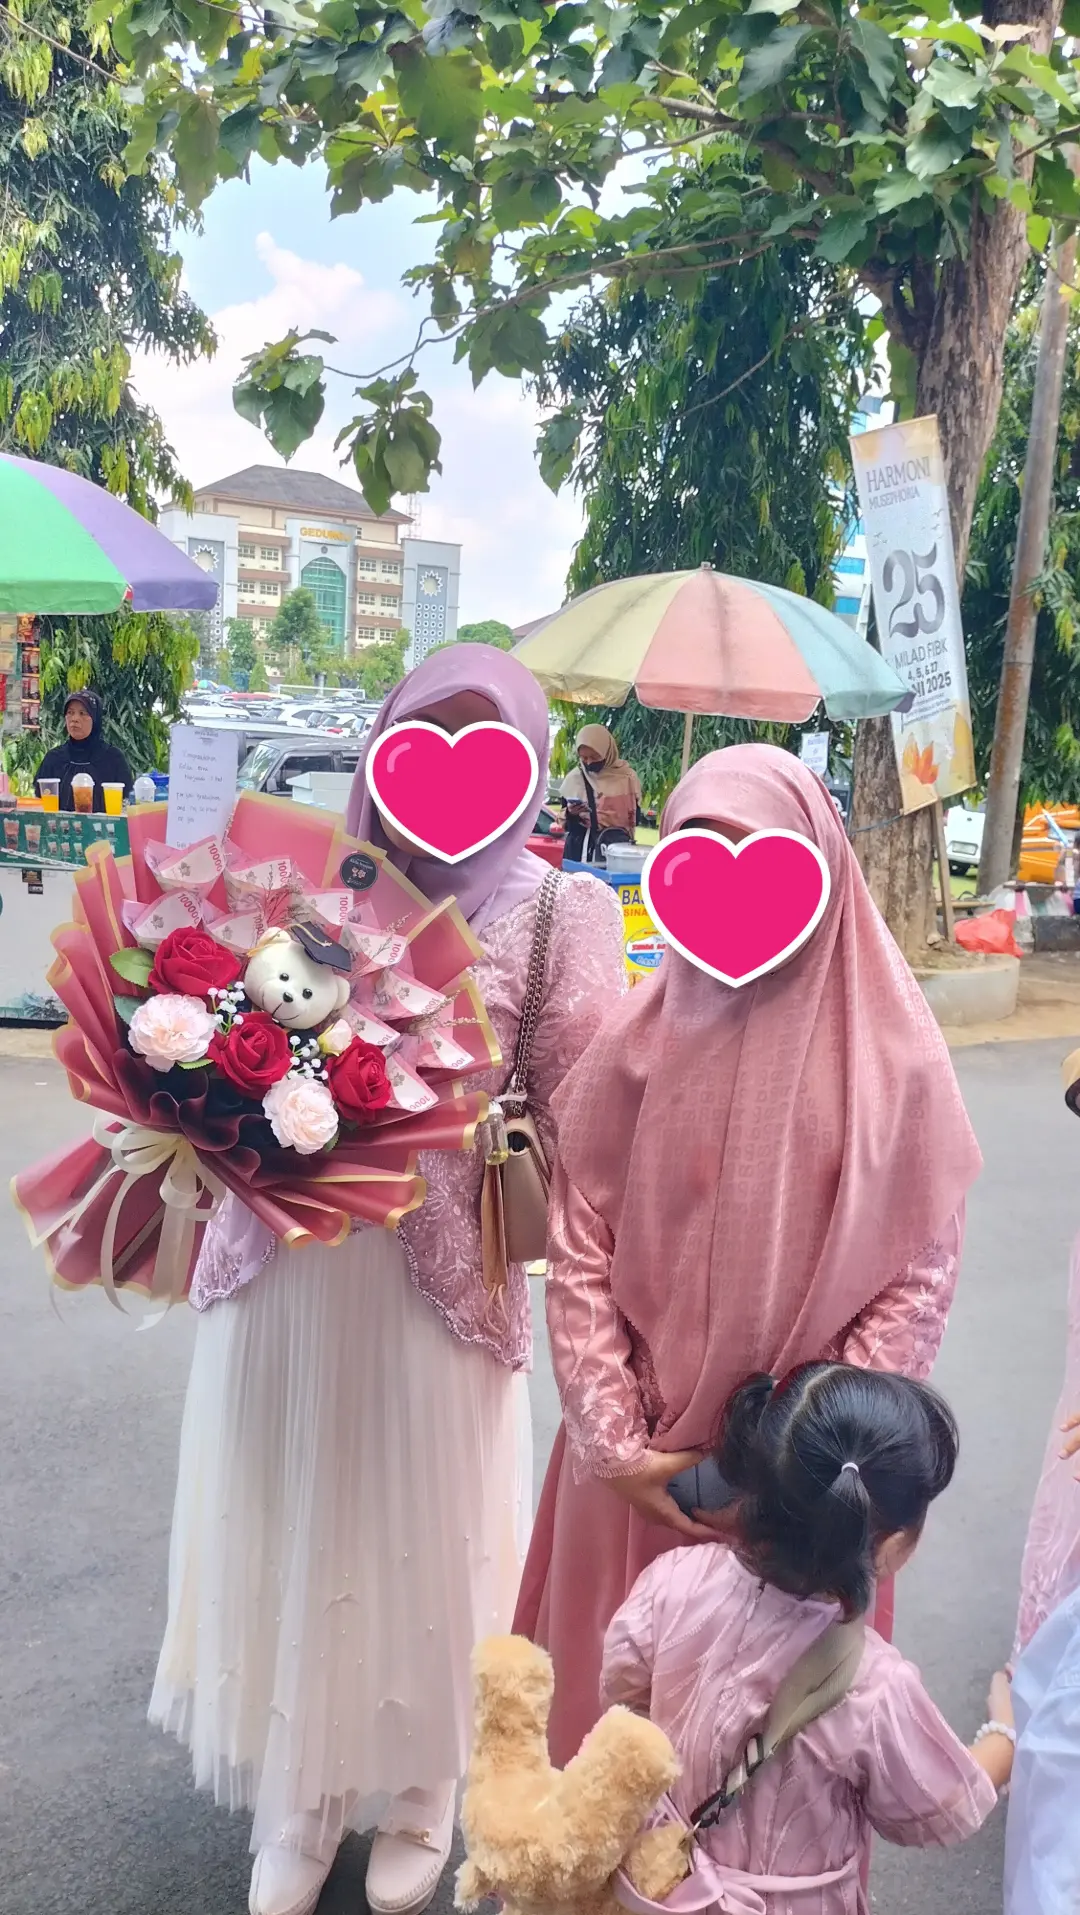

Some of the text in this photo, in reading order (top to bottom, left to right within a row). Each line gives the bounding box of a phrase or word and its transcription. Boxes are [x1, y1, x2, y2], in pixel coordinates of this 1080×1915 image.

[866, 456, 931, 493] HARMONI
[882, 542, 945, 638] 25
[894, 646, 926, 669] MILAD
[911, 671, 952, 697] NI 2025
[622, 889, 645, 905] BA
